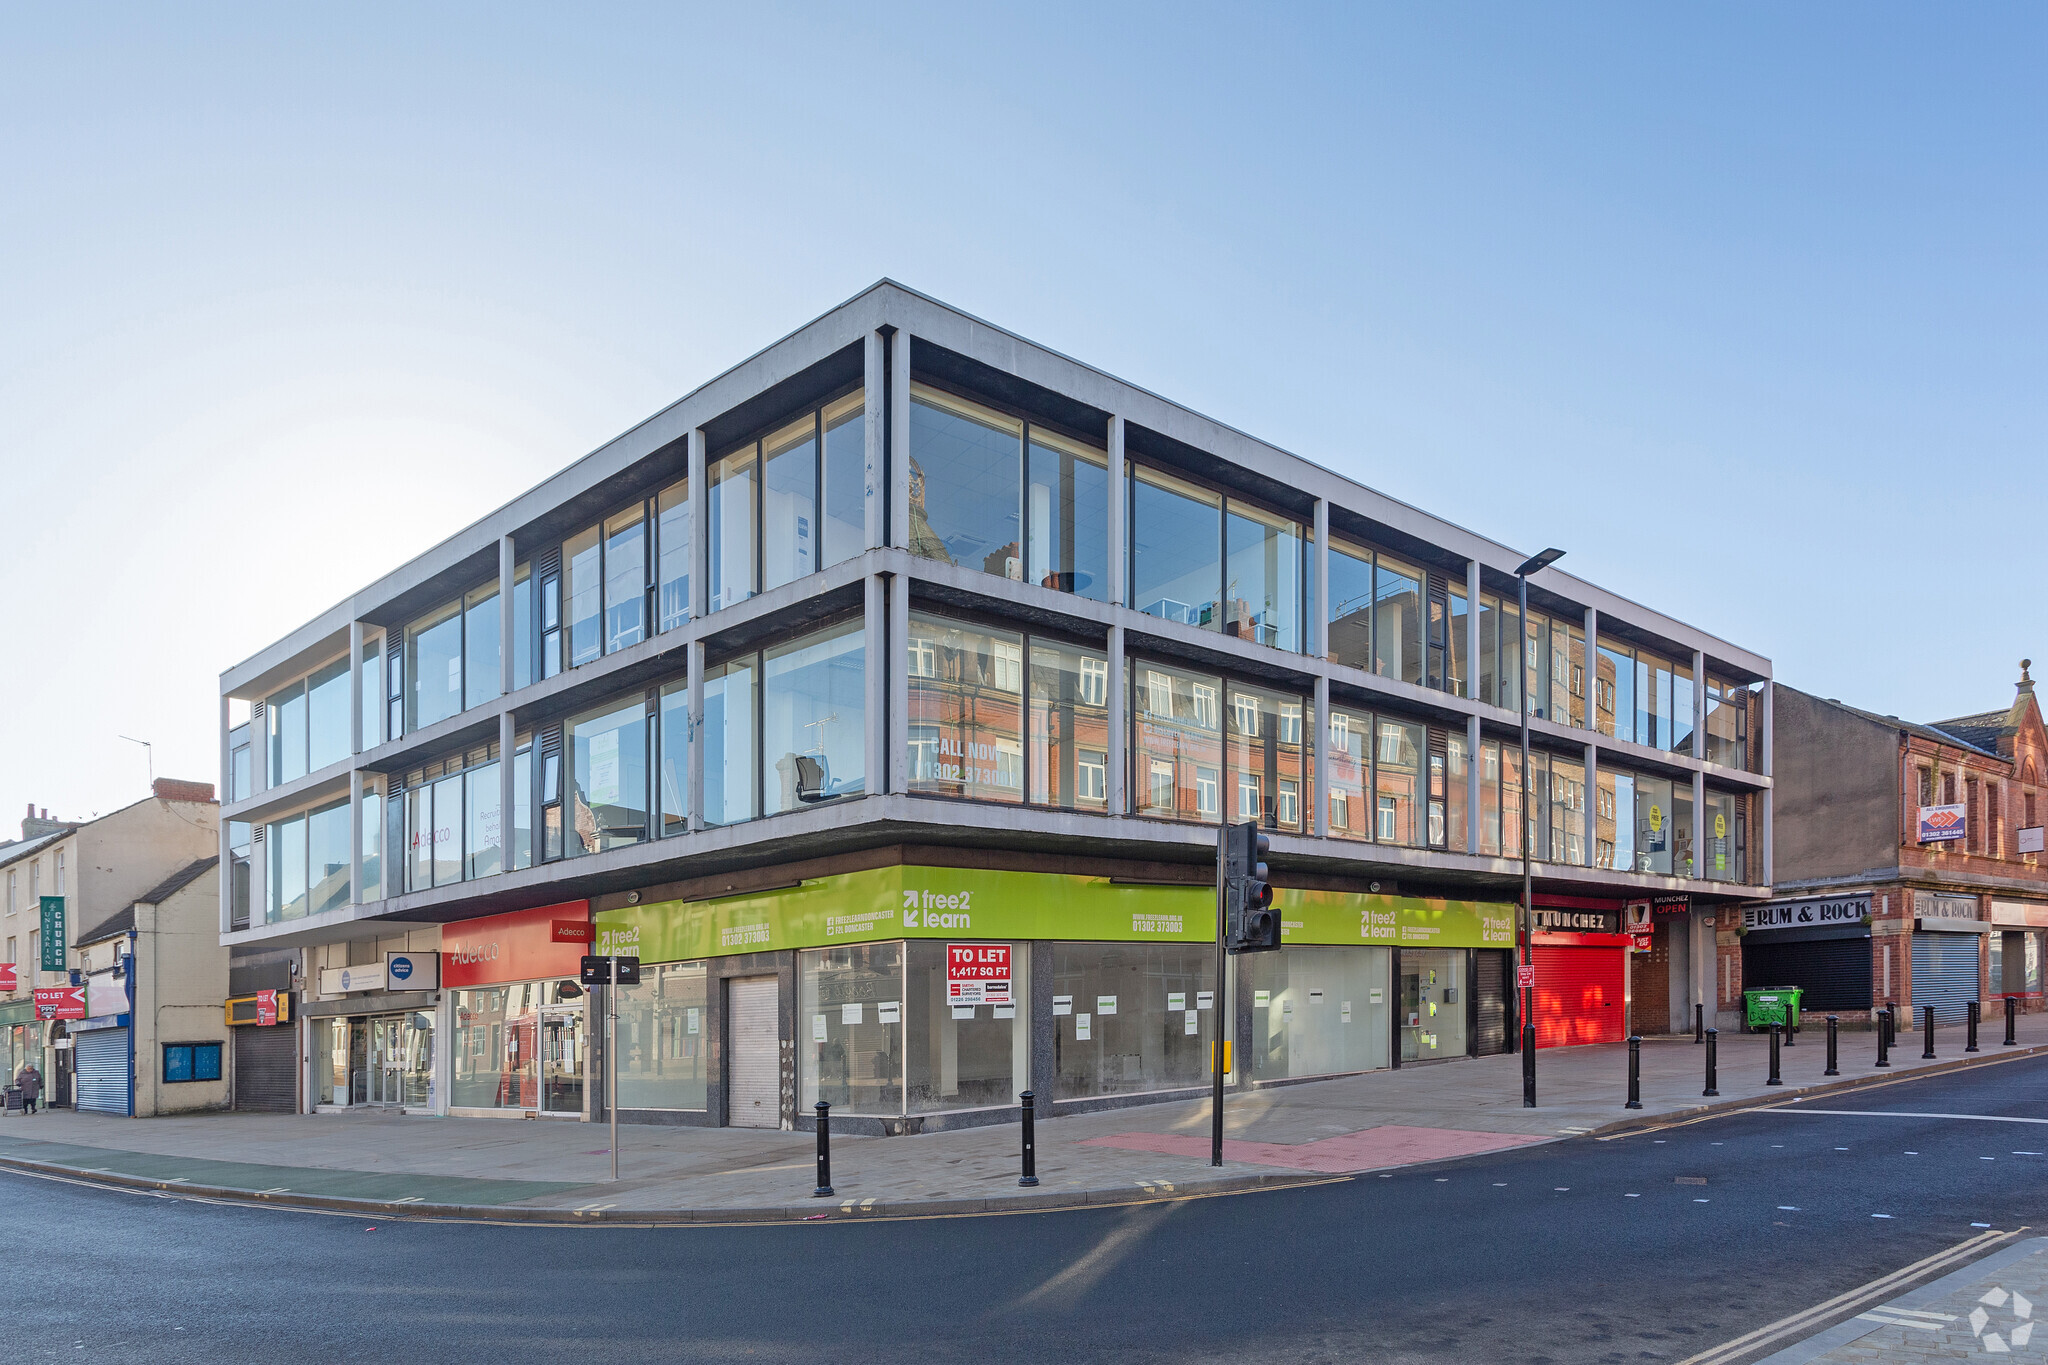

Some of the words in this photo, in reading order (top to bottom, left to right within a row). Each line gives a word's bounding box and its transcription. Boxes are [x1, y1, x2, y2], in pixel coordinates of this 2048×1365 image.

[930, 736, 964, 758] CALL
[968, 741, 1001, 762] NOW
[412, 827, 450, 850] Adecco
[921, 889, 970, 910] free2
[1654, 895, 1688, 903] MUNCHEZ
[1657, 904, 1687, 914] OPEN
[1745, 909, 1755, 928] THE
[1757, 907, 1792, 926] RUM
[1797, 905, 1814, 923] &
[1819, 900, 1868, 921] ROCK
[1921, 899, 1939, 917] RUM
[1941, 900, 1949, 918] &
[1951, 901, 1973, 919] ROCK
[923, 908, 970, 929] learn
[1371, 910, 1396, 924] free2
[1490, 916, 1511, 930] free2
[1543, 911, 1605, 929] MUNCHEZ
[557, 927, 585, 936] Adecco
[1132, 920, 1155, 932] 01302
[1156, 921, 1183, 933] 373003
[1371, 923, 1396, 938] learn
[54, 911, 63, 966] CHURCH
[611, 926, 640, 944] free2
[721, 933, 743, 946] 01302
[744, 930, 770, 944] 373003
[1490, 928, 1511, 941] learn
[451, 940, 499, 965] Adecco
[611, 944, 640, 957] learn
[952, 948, 974, 963] TO
[978, 948, 1006, 963] LET
[951, 966, 978, 978] 1,417
[980, 966, 993, 976] SQ
[995, 966, 1008, 976] FT
[37, 992, 49, 1000] TO
[50, 991, 64, 999] LET
[460, 1012, 478, 1020] Adecco
